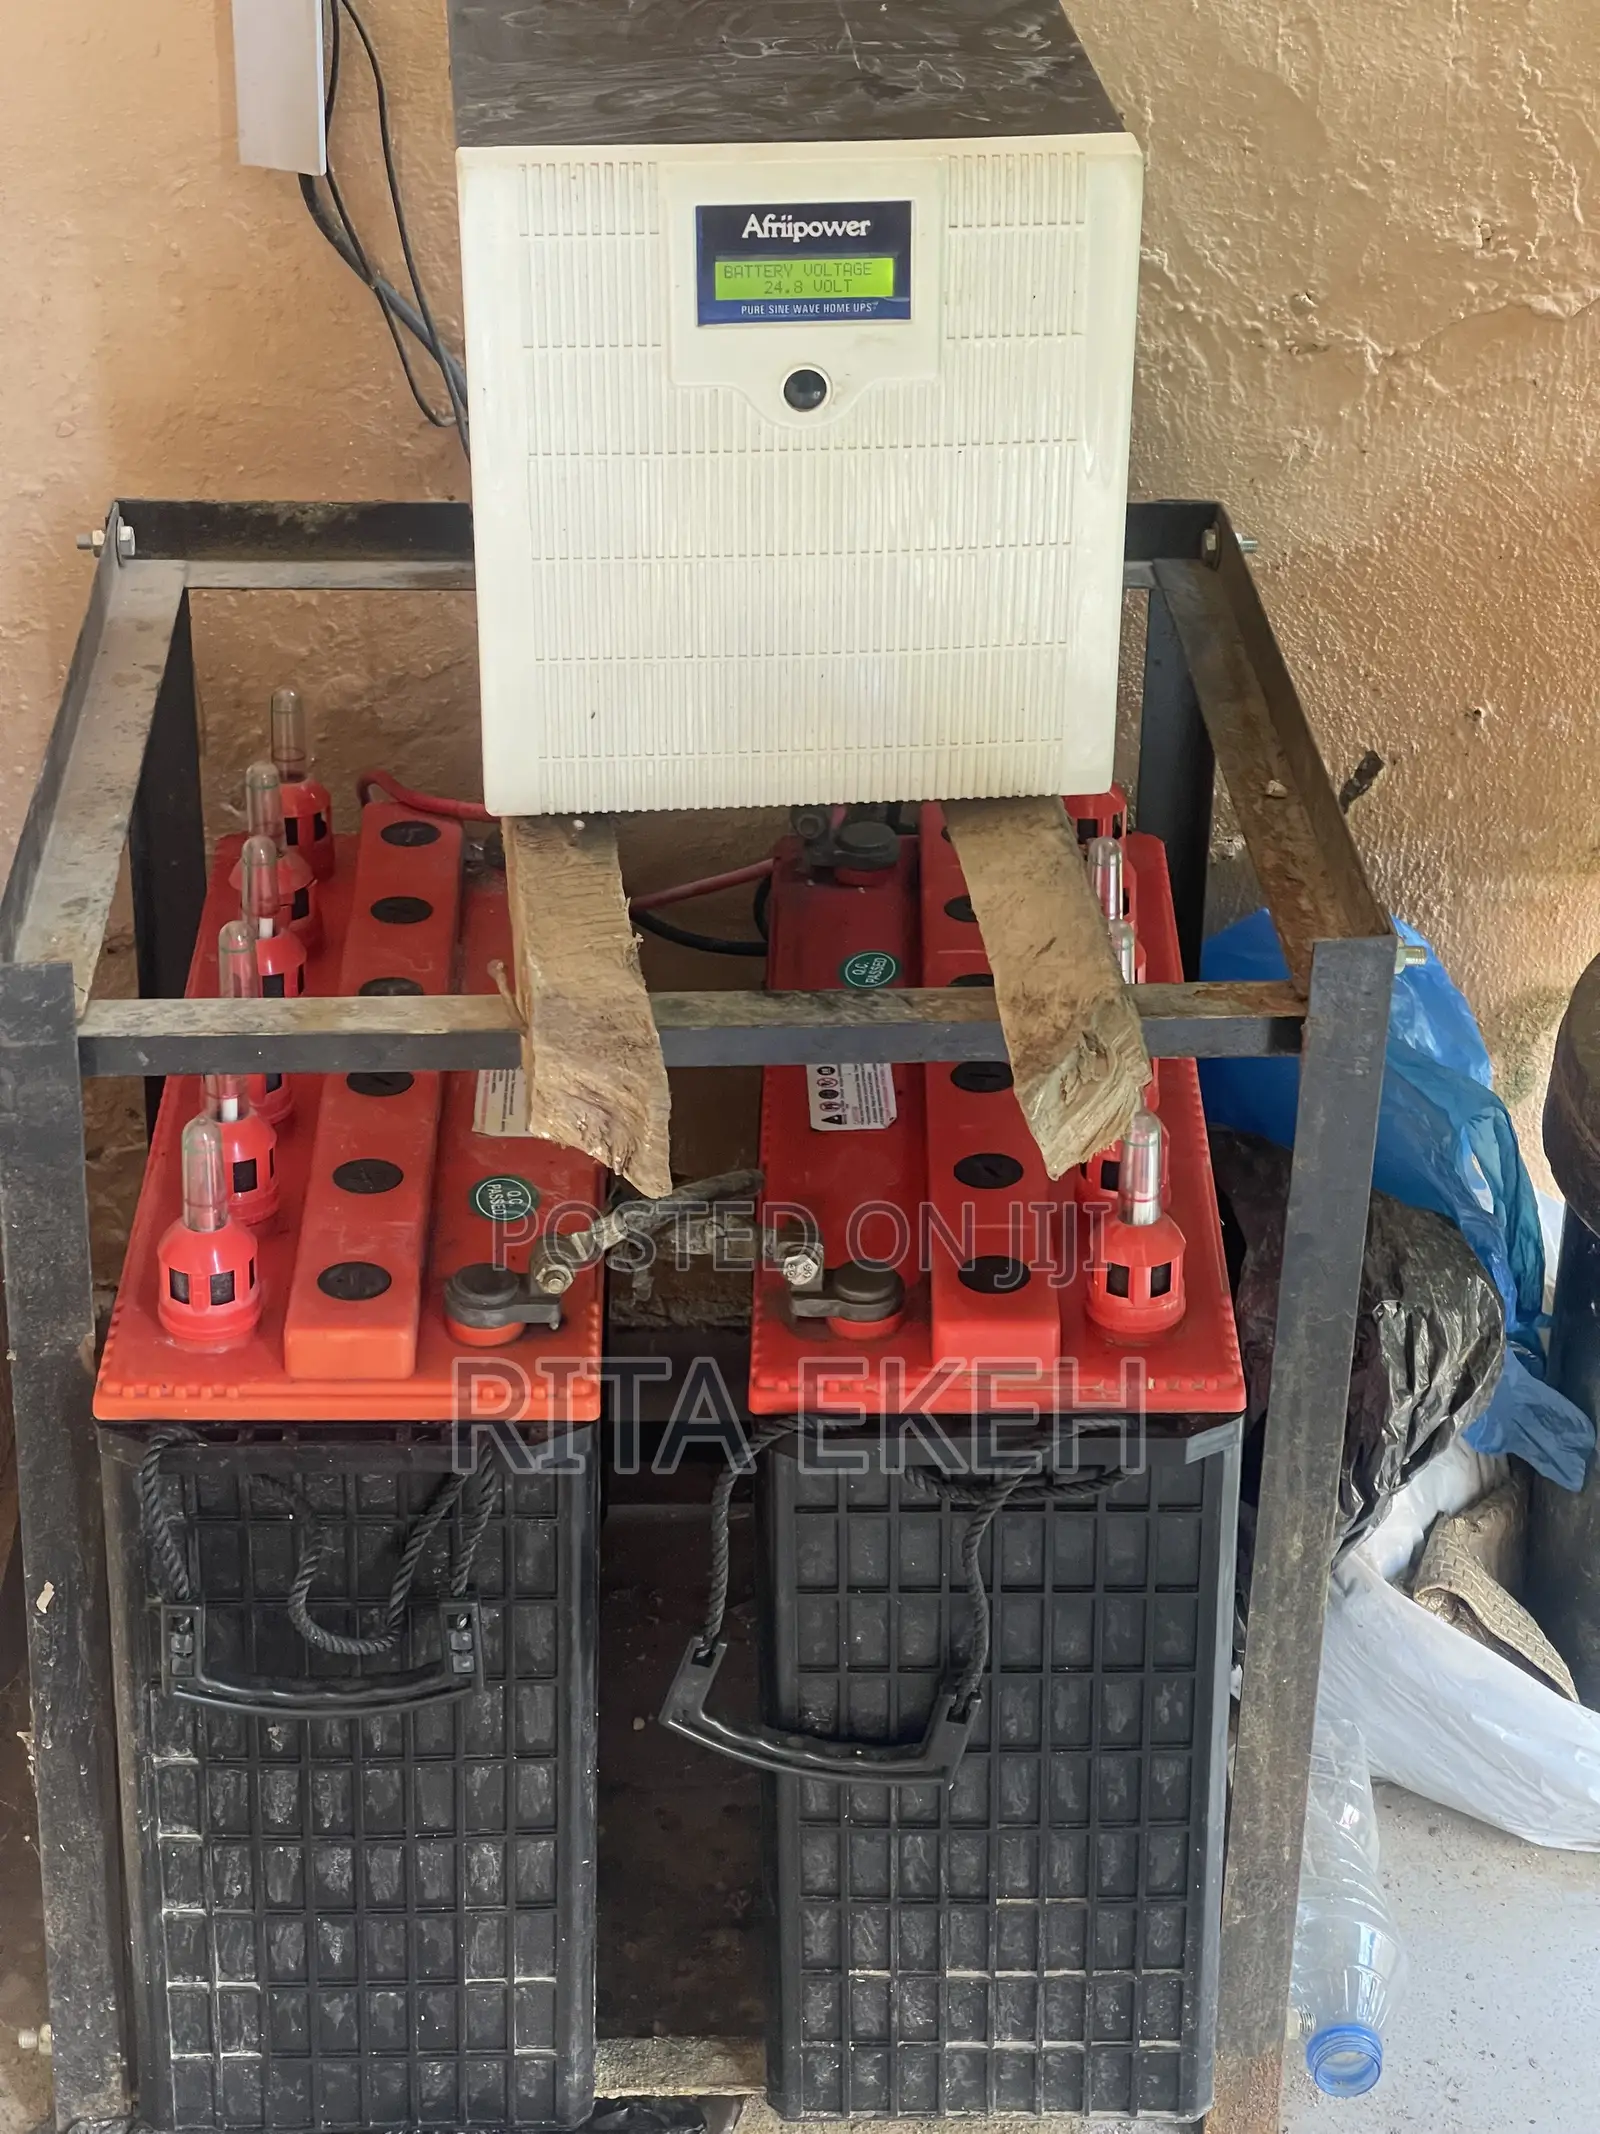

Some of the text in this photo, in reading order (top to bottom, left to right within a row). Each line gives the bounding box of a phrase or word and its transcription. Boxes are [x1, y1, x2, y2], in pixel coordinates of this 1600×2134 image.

[742, 213, 871, 243] Afriipower
[723, 261, 873, 279] BATTERY VOLTAGE
[764, 278, 852, 294] 24.8 VOLT
[741, 302, 872, 315] PURE SINE WAVE HOME UPS
[865, 957, 887, 984] PASSED
[487, 1184, 507, 1215] PASSED
